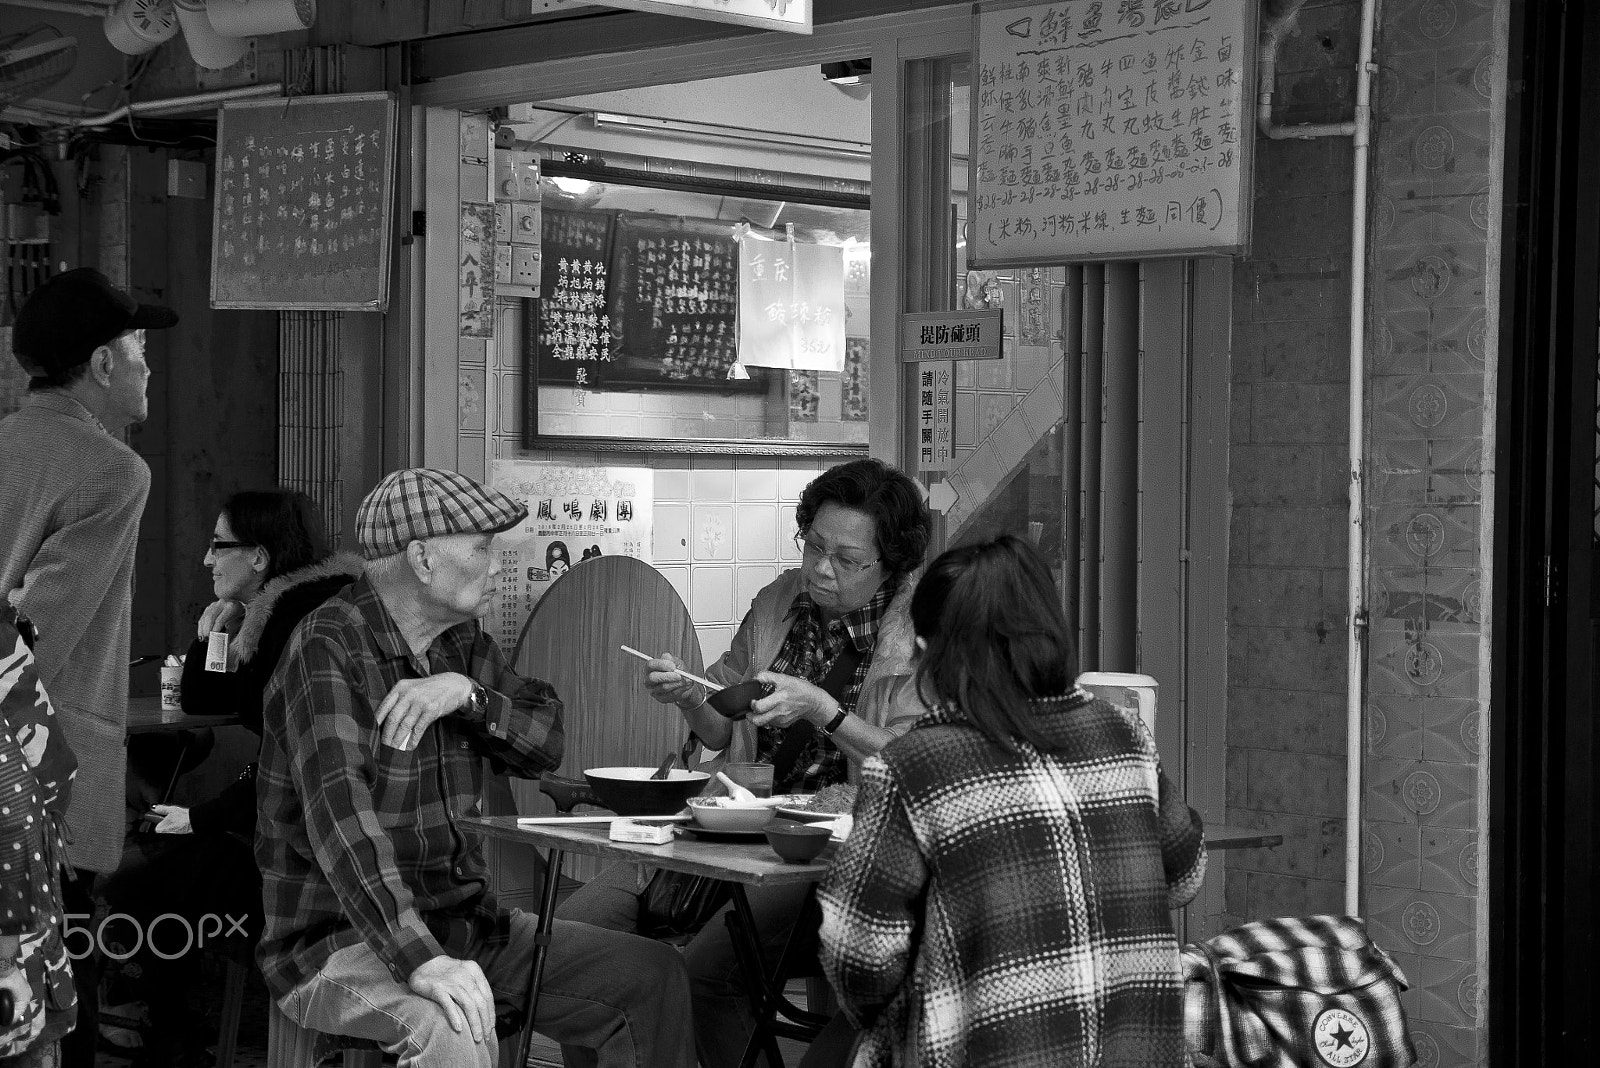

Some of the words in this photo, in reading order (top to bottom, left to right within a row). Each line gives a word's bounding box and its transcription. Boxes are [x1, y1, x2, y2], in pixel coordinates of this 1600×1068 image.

[920, 323, 981, 345] 提防碰頭
[913, 349, 936, 359] MIND
[937, 348, 961, 358] YOUR
[962, 347, 987, 357] HEAD
[921, 371, 934, 464] 請隨手關門
[937, 369, 950, 463] 冷氣開放中
[536, 499, 633, 522] 鳳鳴劇團
[1319, 1012, 1359, 1032] CONVERSE
[1326, 1051, 1341, 1063] ALL
[1344, 1048, 1363, 1064] STAR
